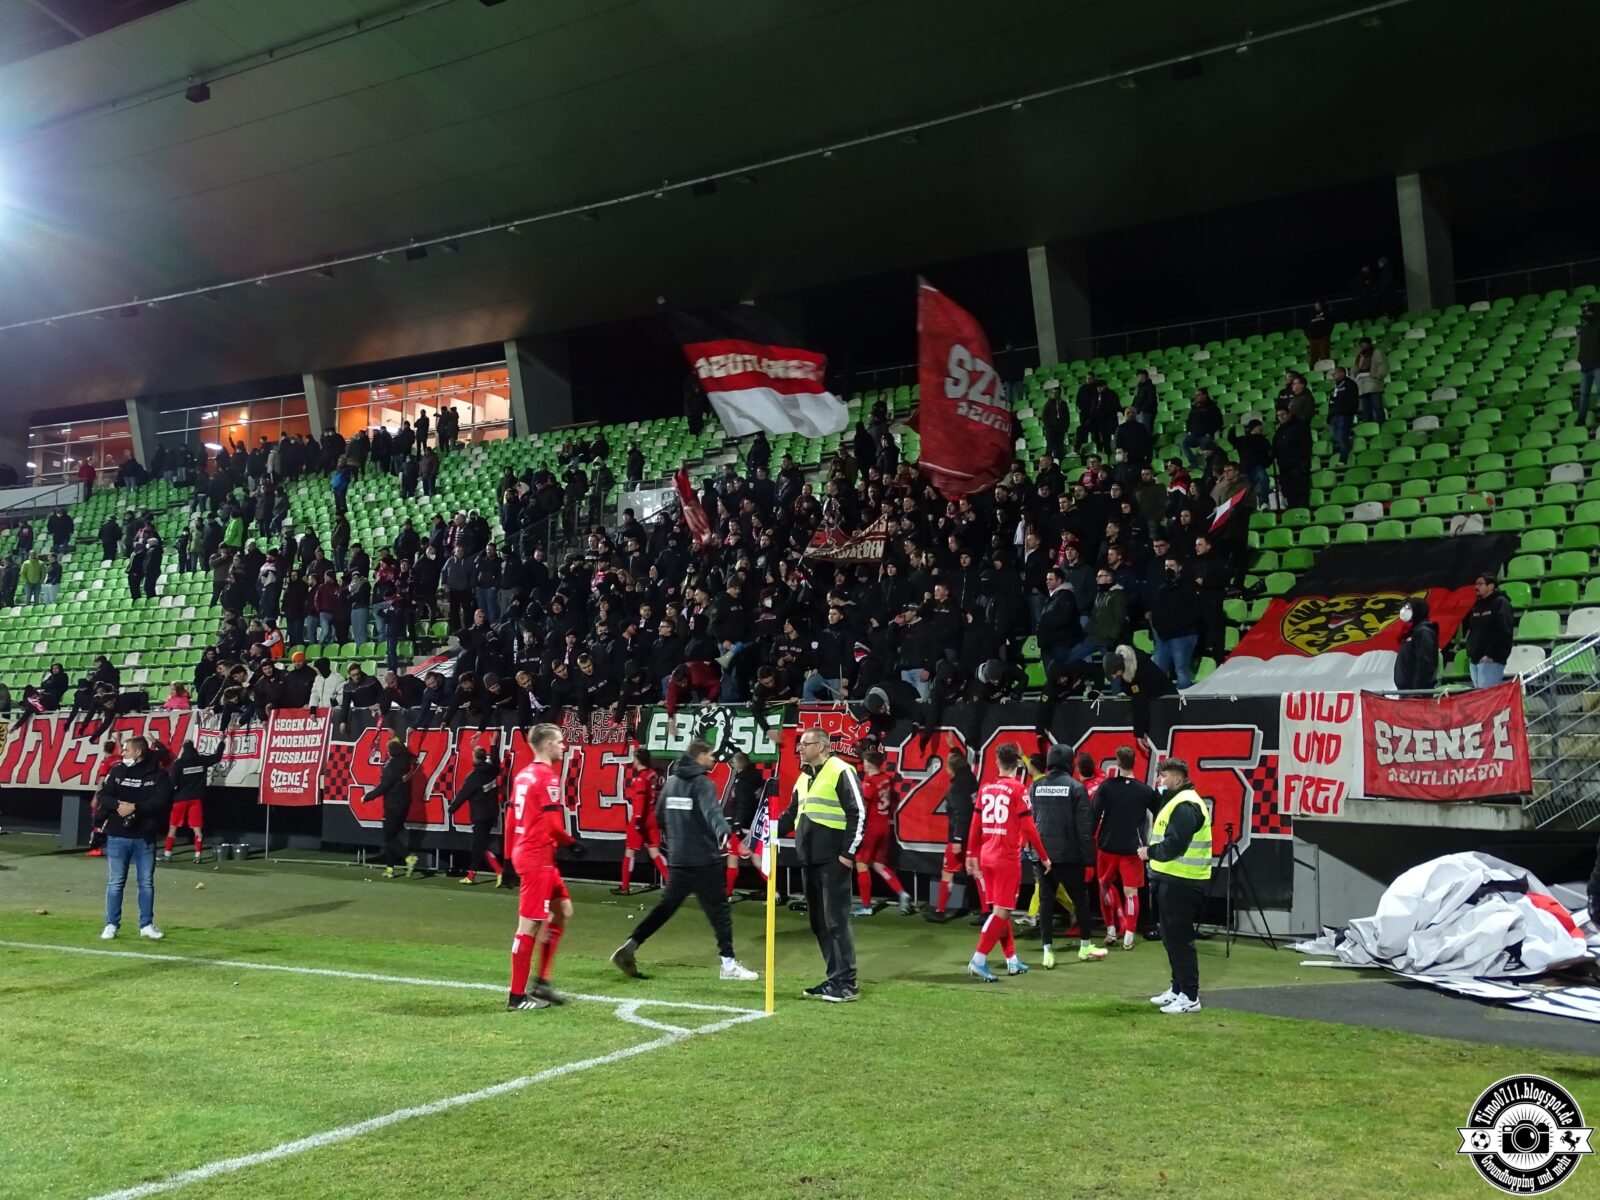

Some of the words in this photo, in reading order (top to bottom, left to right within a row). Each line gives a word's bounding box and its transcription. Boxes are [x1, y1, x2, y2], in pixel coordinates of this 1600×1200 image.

[1286, 691, 1354, 724] WILD
[274, 719, 305, 731] GEGEN
[305, 717, 326, 730] DEN
[1374, 719, 1486, 766] SZENE
[1493, 707, 1514, 760] E
[271, 734, 322, 748] MODERNEN
[1293, 730, 1342, 765] UND
[268, 751, 319, 764] FUSSBALL!
[270, 768, 301, 789] SZENE
[302, 768, 310, 788] E
[1036, 787, 1068, 795] uhlsport
[514, 783, 528, 820] 5
[981, 793, 1010, 824] 26
[1284, 775, 1345, 814] FREI
